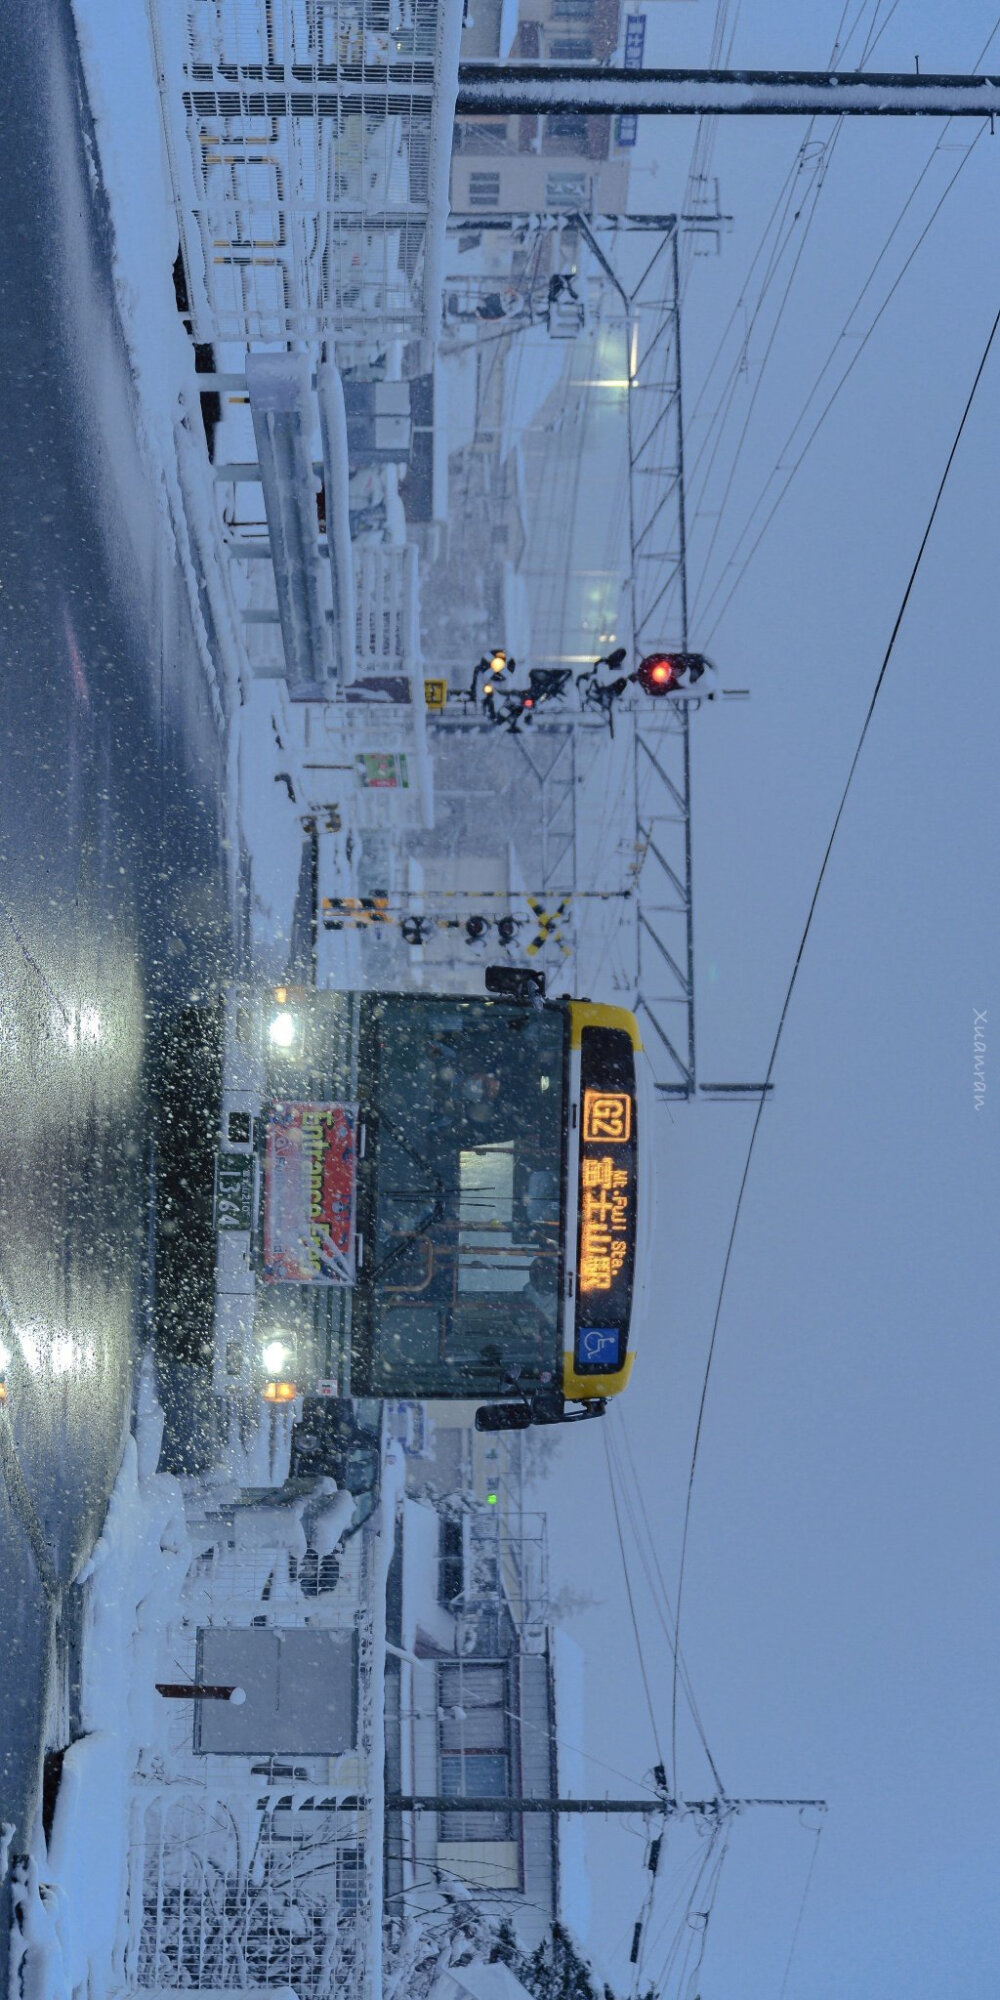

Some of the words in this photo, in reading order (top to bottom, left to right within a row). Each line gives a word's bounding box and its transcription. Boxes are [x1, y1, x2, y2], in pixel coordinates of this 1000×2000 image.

[591, 1098, 625, 1136] G2
[301, 1111, 334, 1218] Entrance
[581, 1157, 613, 1290] 富士山駅
[611, 1240, 627, 1276] Sta.
